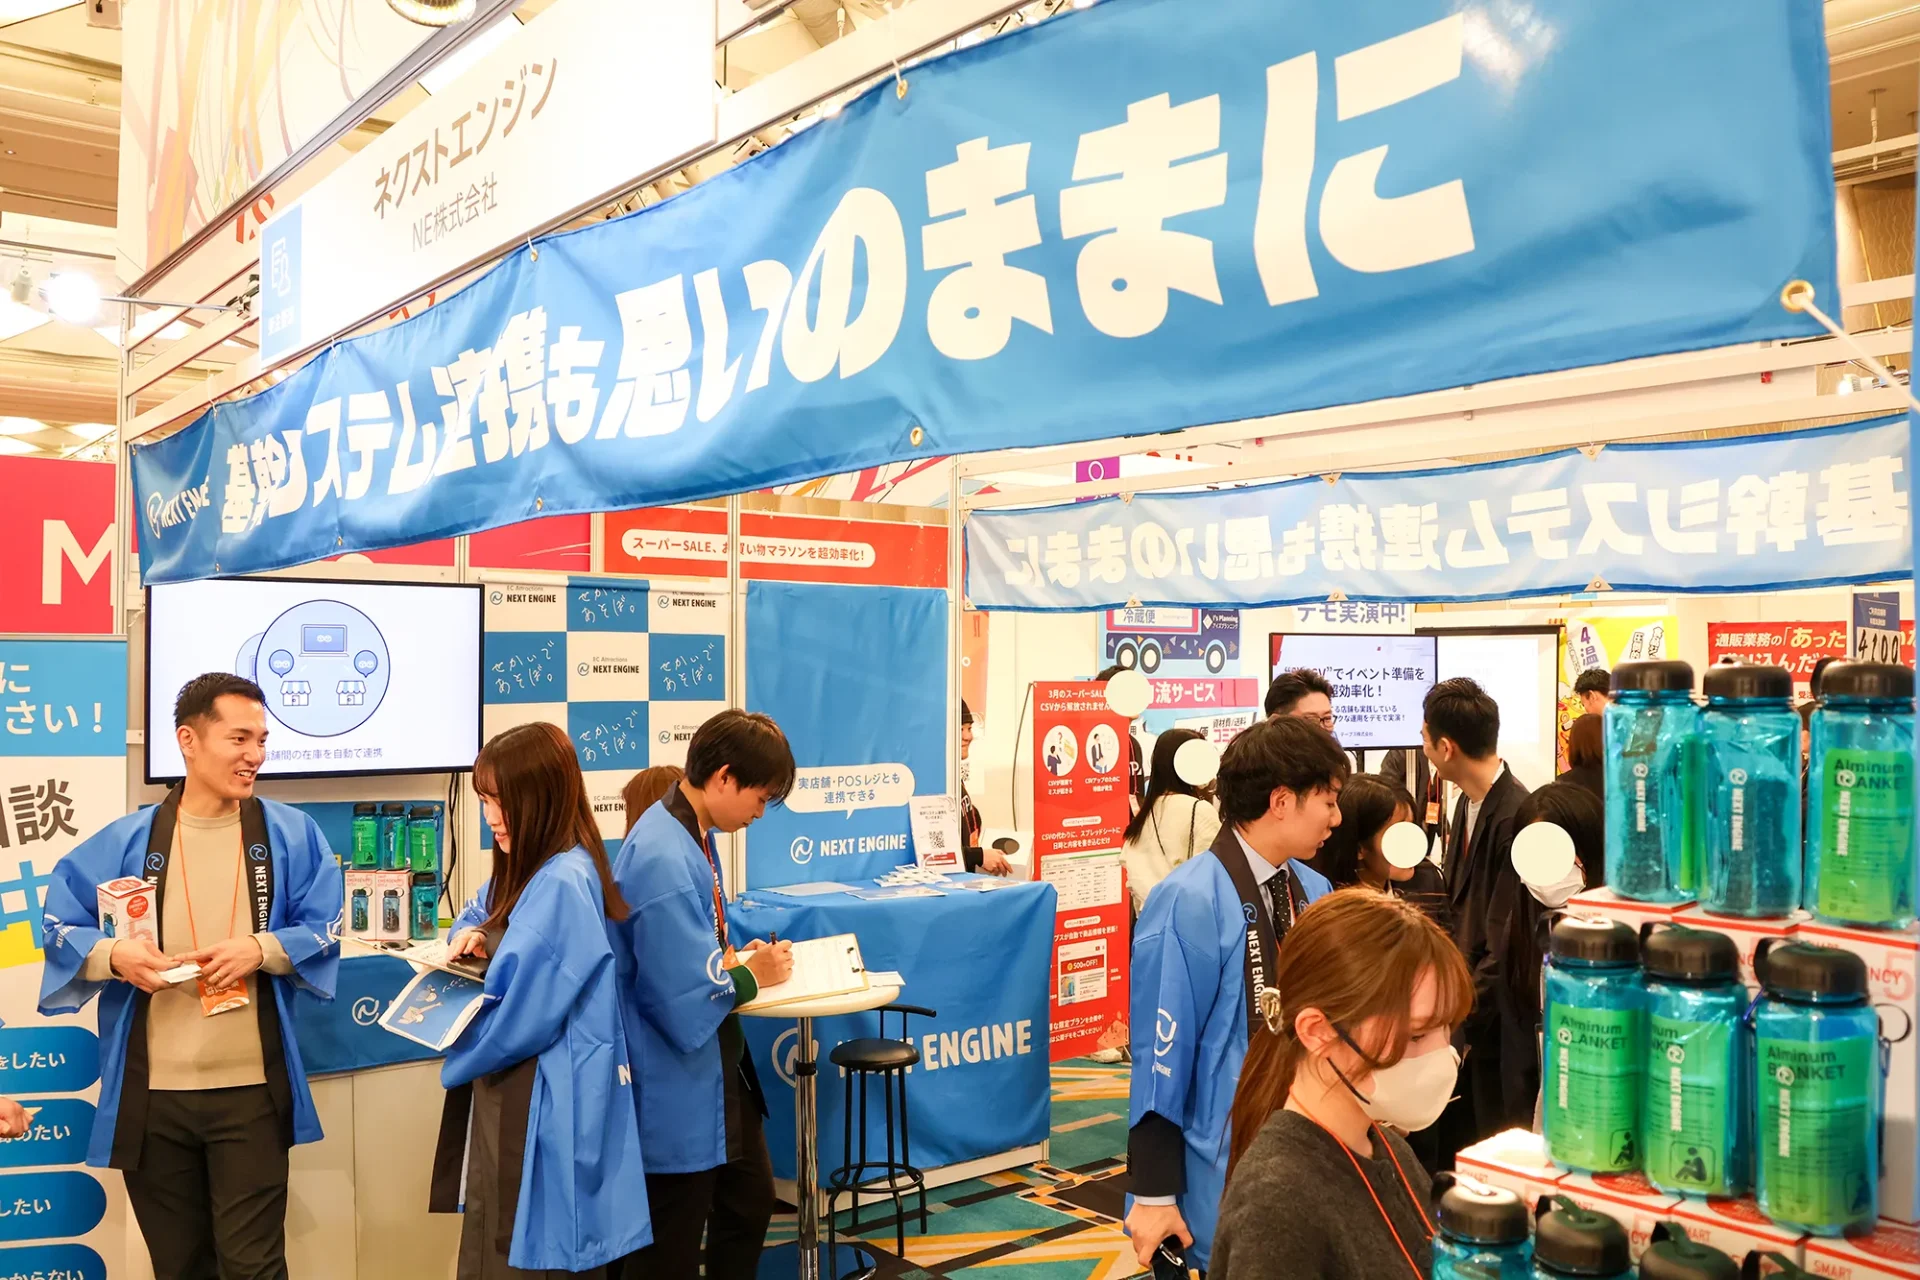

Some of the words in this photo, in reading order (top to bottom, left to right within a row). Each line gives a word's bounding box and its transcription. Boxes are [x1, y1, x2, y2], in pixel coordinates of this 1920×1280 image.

[373, 56, 558, 220] ネクストエンジン
[411, 171, 499, 252] NE株式会社
[506, 594, 527, 603] NEXT
[529, 594, 557, 604] ENGINE
[672, 598, 690, 608] NEXT
[691, 598, 717, 608] ENGINE
[1219, 615, 1239, 623] Planning
[593, 665, 611, 674] NEXT
[613, 664, 640, 674] ENGINE
[1048, 688, 1107, 699] 3月のスーパーSAL
[1149, 681, 1216, 704] 流サービス
[1040, 702, 1112, 712] CSVから解放されません
[1331, 705, 1397, 714] る店舗も実践している
[674, 733, 691, 742] NEXT
[1834, 759, 1905, 775] Alminum
[798, 772, 901, 790] 実店舗・POSレジとも
[824, 789, 875, 805] 連携できる
[1732, 788, 1744, 814] NEXT
[0, 779, 78, 848] 談
[594, 804, 612, 812] NEXT
[1731, 815, 1743, 851] ENGINE
[820, 838, 854, 857] NEXT
[858, 833, 907, 854] ENGINE
[254, 865, 268, 894] NEXT
[1247, 930, 1262, 963] NEXT
[1560, 1016, 1622, 1035] Alminum
[923, 1019, 1032, 1071] ENGINE
[1561, 1031, 1628, 1050] LANKET
[1559, 1048, 1569, 1073] NEXT
[1768, 1046, 1836, 1063] Alminum
[1671, 1067, 1682, 1093] NEXT
[1768, 1063, 1846, 1081] BANKET
[1559, 1074, 1569, 1109] ENGINE
[1670, 1094, 1682, 1132] ENGINE
[1780, 1089, 1791, 1117] NEXT
[1778, 1118, 1791, 1158] ENGINE
